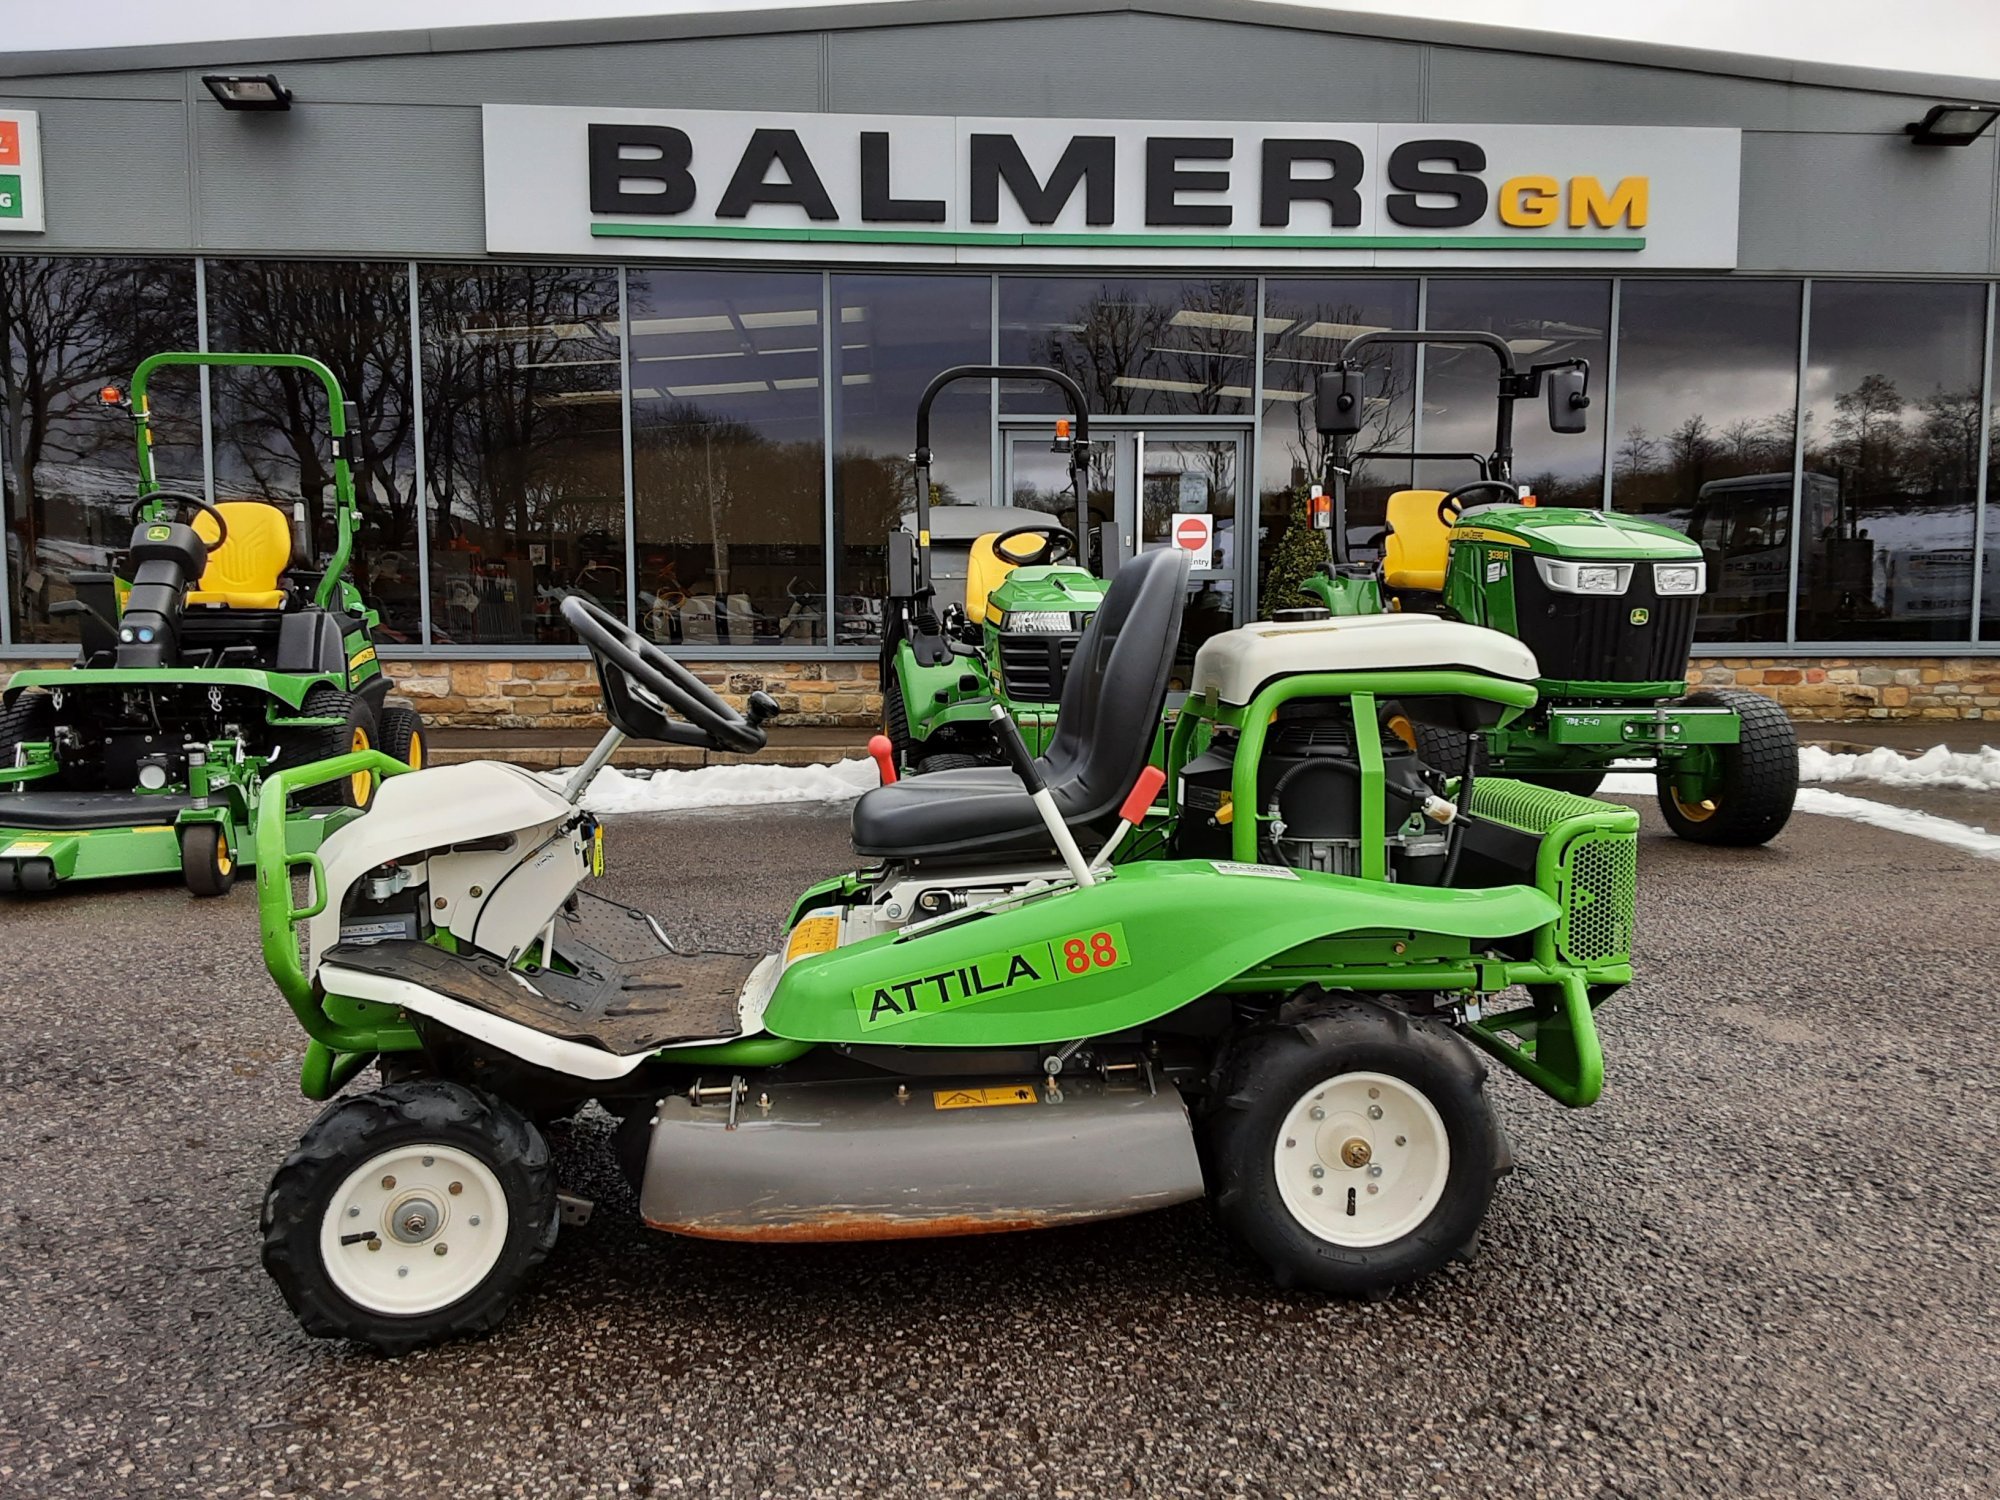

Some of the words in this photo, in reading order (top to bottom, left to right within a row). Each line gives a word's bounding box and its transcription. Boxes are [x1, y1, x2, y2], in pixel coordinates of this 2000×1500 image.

[587, 122, 1489, 229] BALMERS
[1498, 175, 1650, 229] GM
[868, 954, 1042, 1023] ATTILA
[1063, 931, 1118, 975] 88
